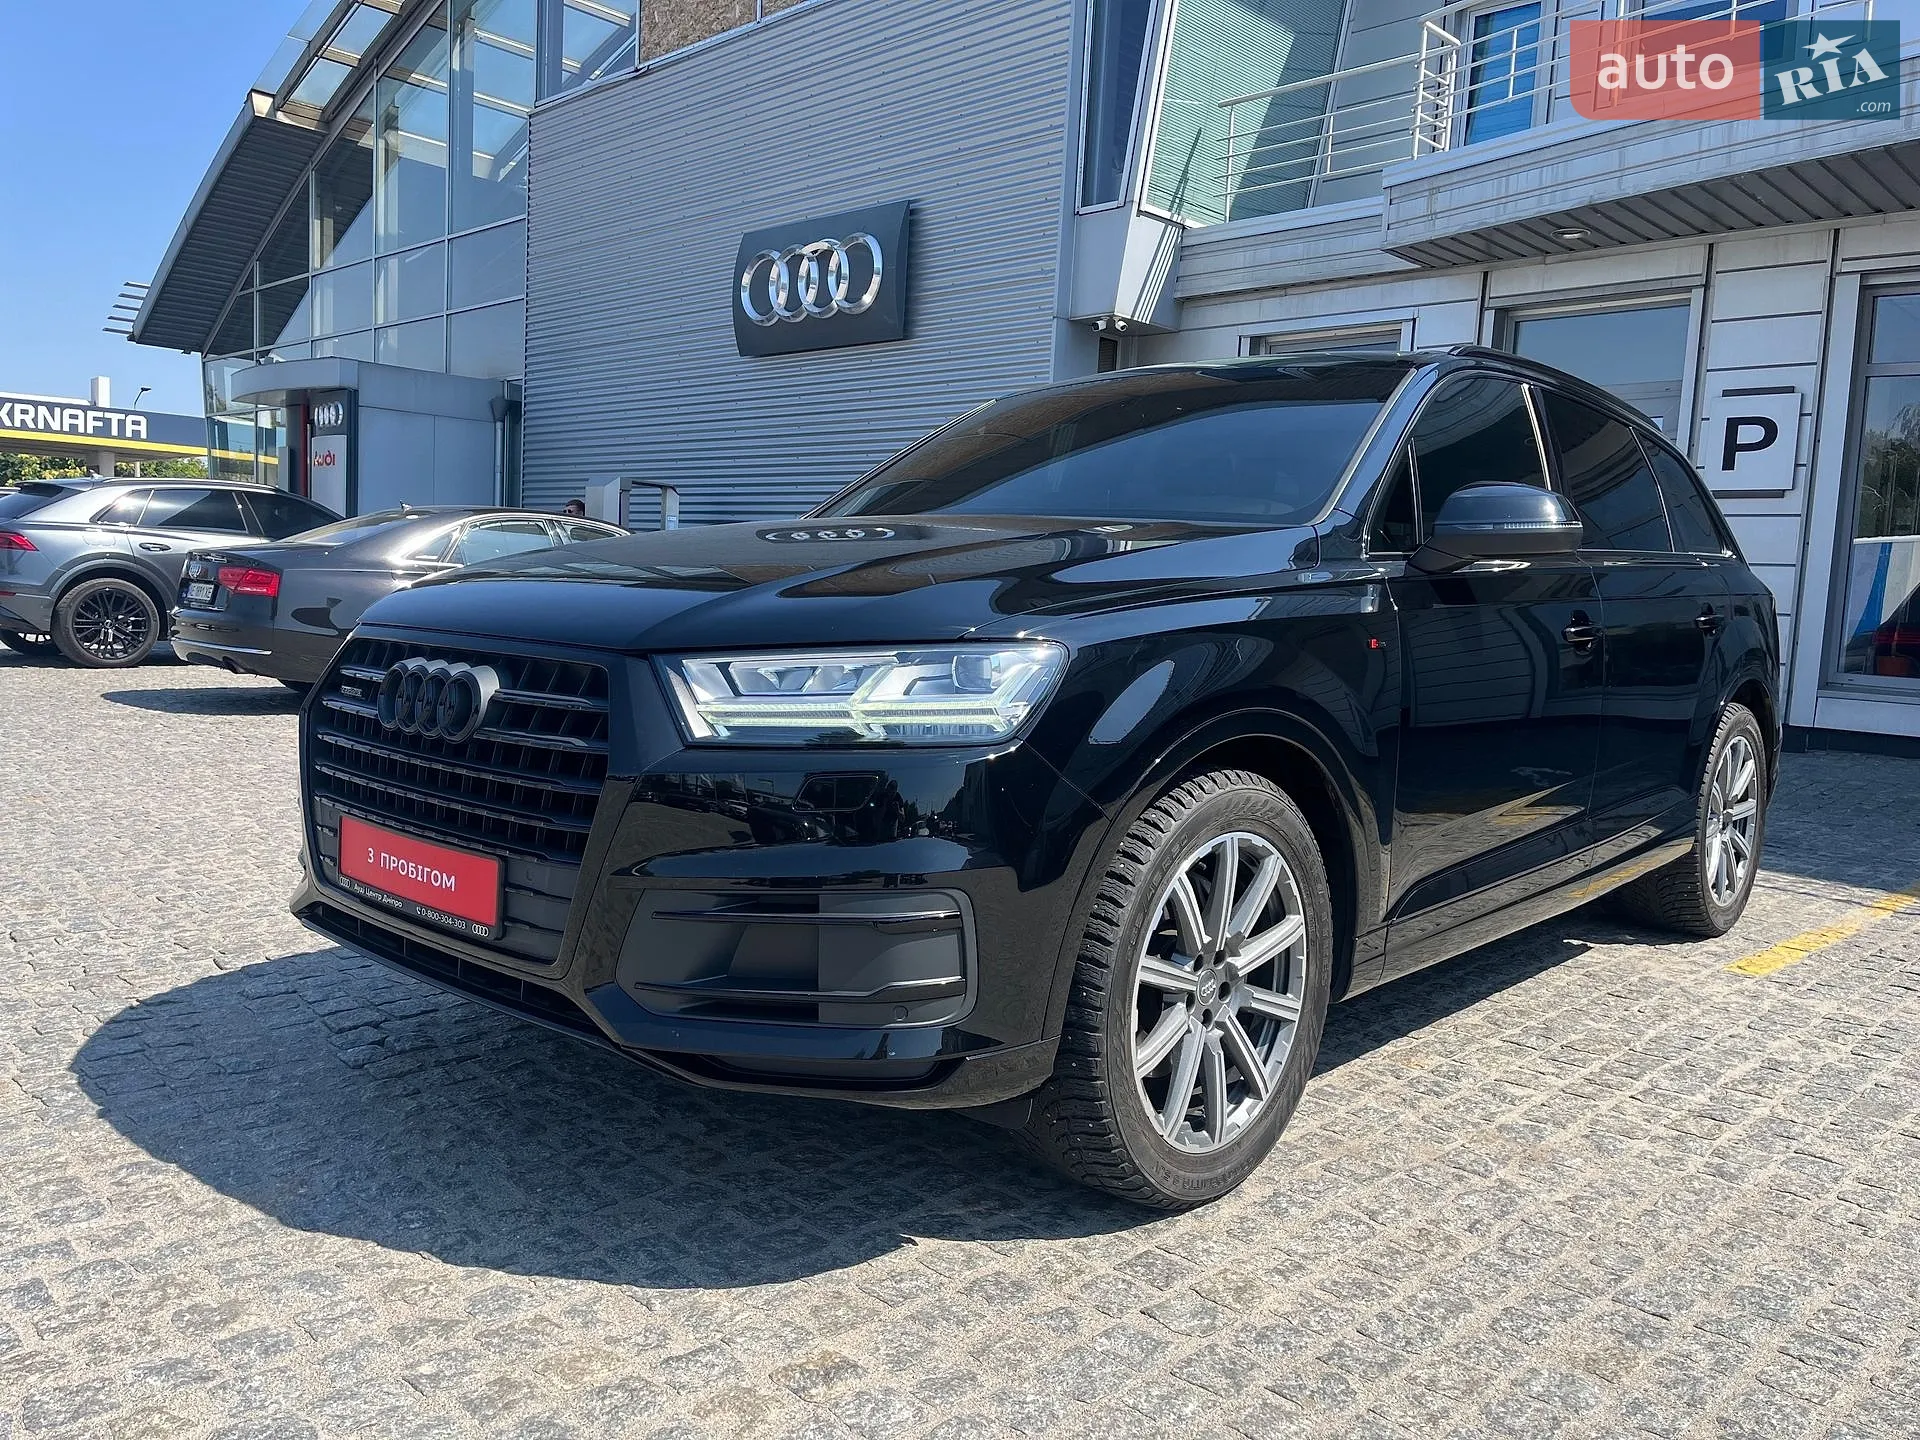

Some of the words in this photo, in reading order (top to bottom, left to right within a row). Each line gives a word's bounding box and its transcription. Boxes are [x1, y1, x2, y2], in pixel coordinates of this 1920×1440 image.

[1721, 415, 1779, 472] P
[380, 852, 456, 892] ПРОБІГОМ
[421, 907, 466, 930] 0-800-304-303
